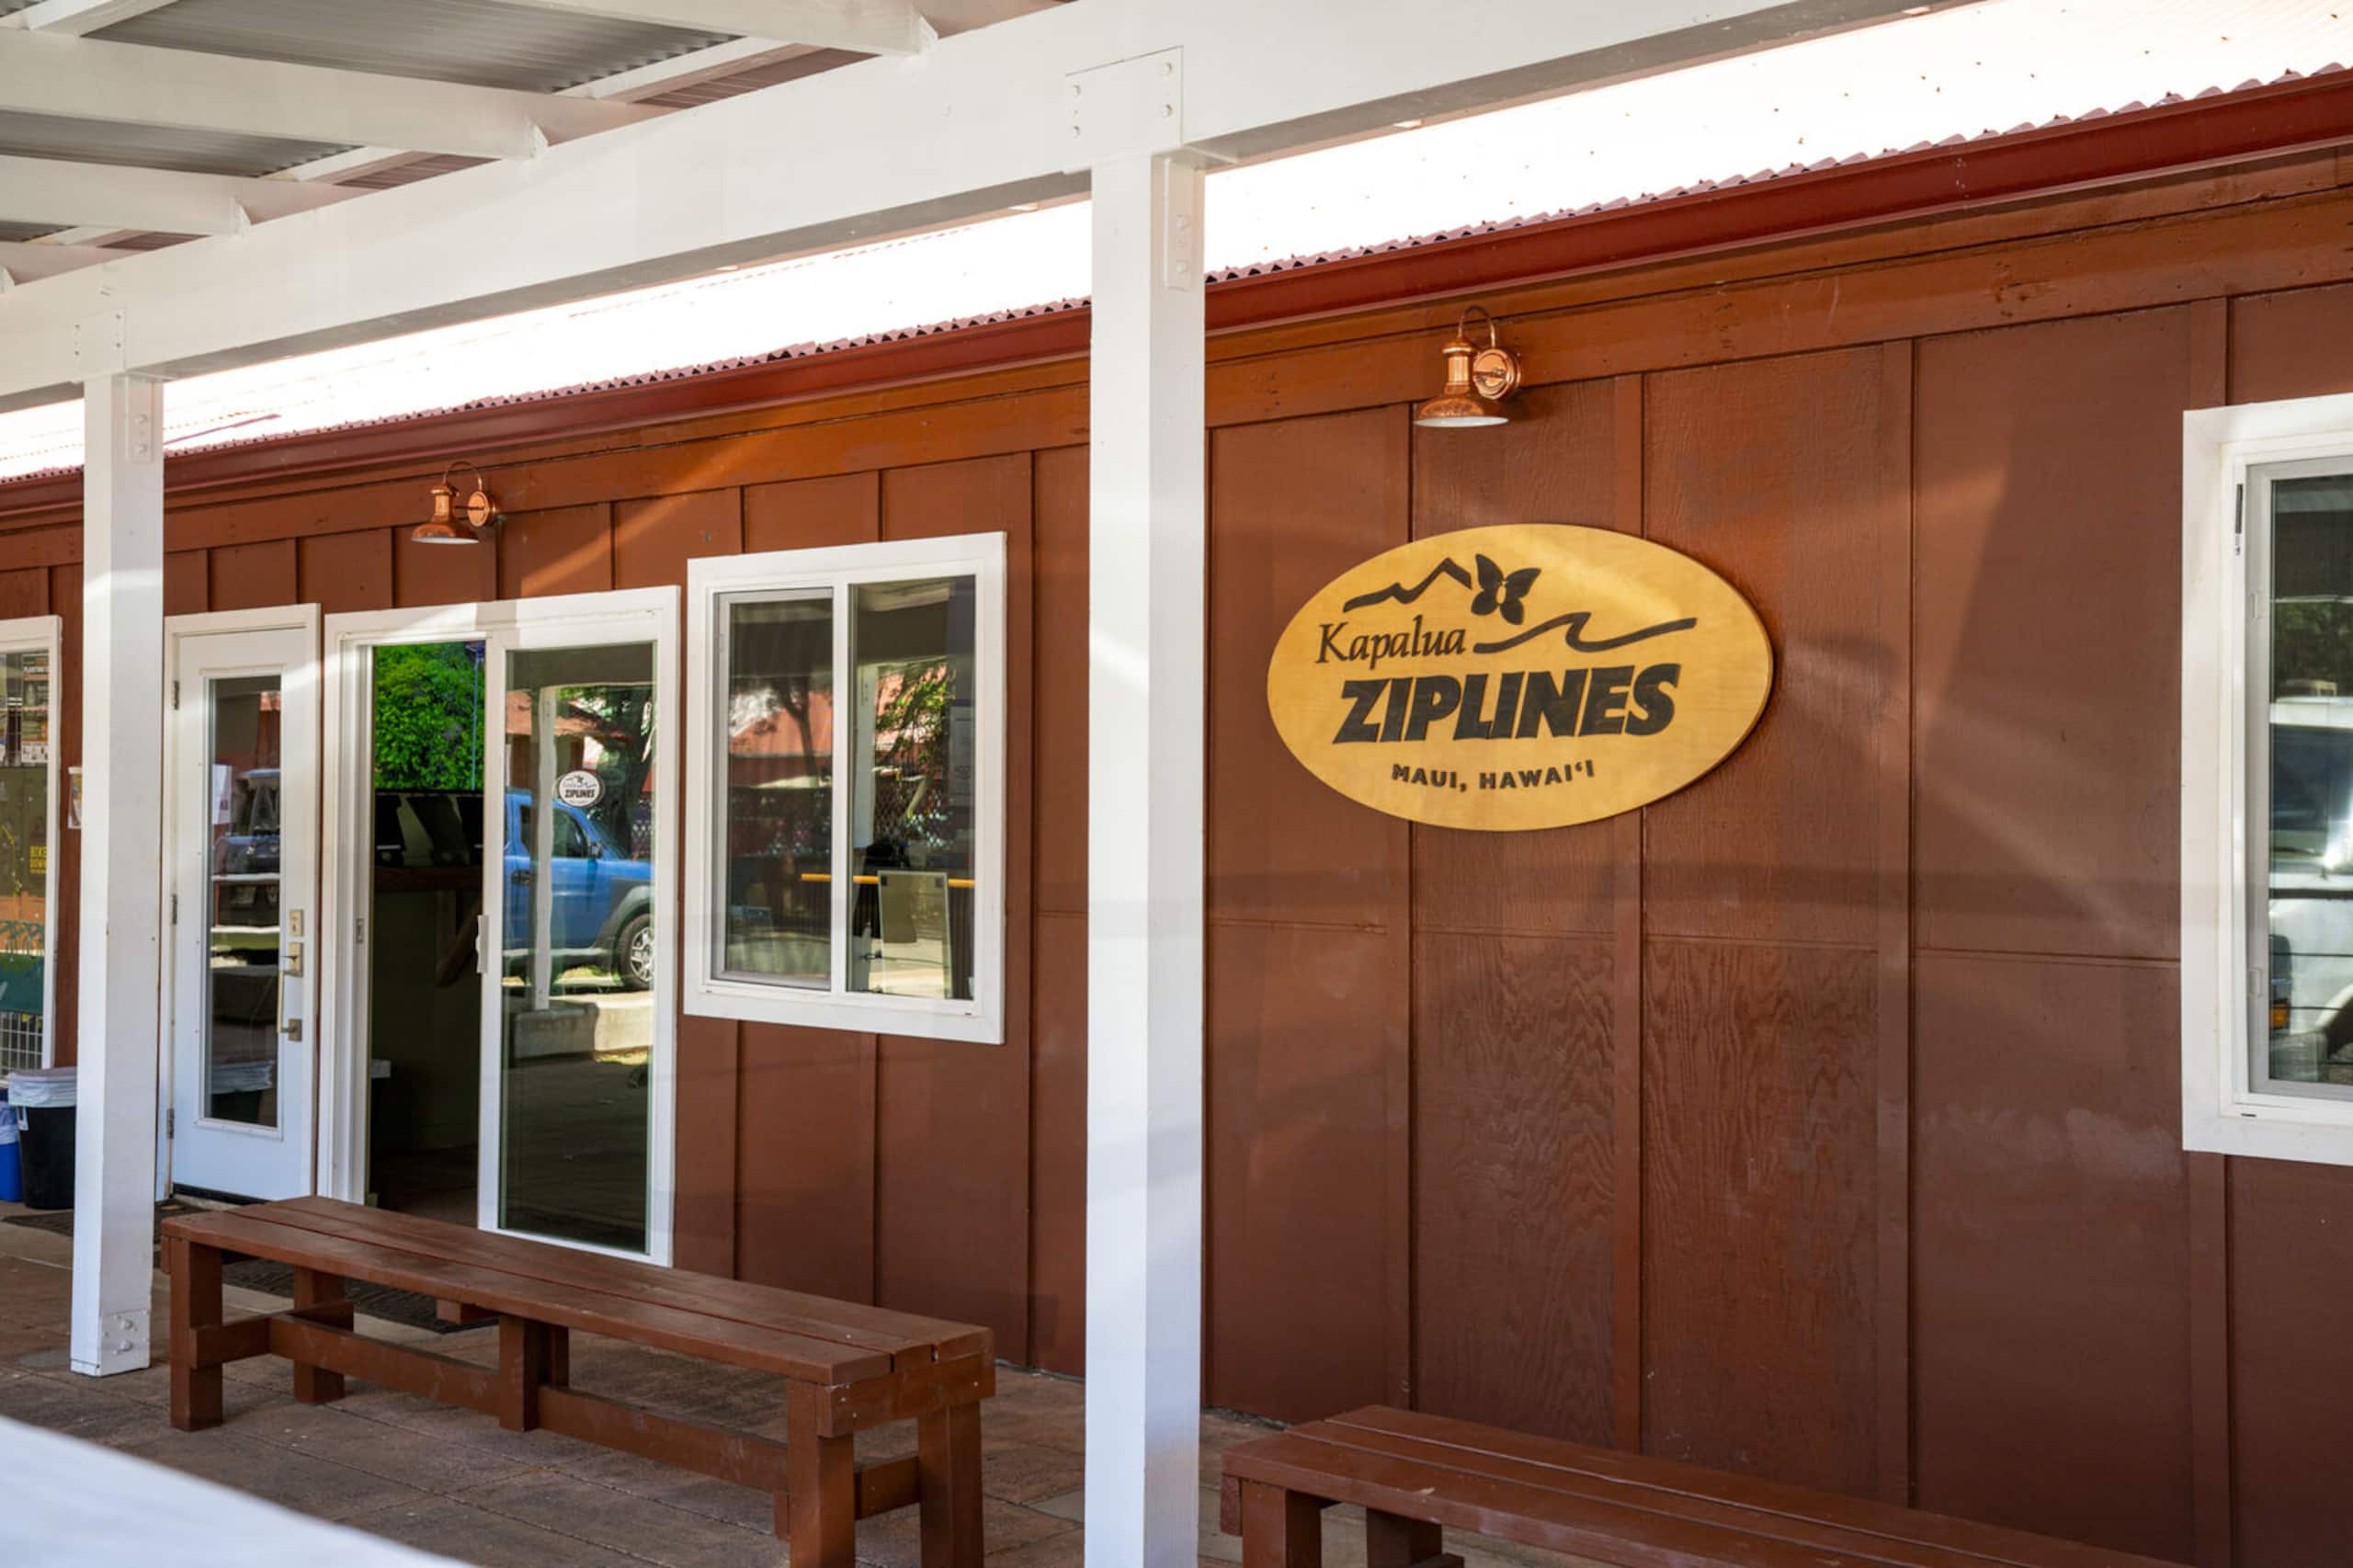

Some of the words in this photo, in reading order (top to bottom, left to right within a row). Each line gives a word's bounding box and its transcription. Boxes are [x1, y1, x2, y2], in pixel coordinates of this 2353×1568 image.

[1316, 615, 1466, 669] Kapalua
[1333, 663, 1681, 744] ZIPLINES
[1392, 765, 1467, 792] MAUI,
